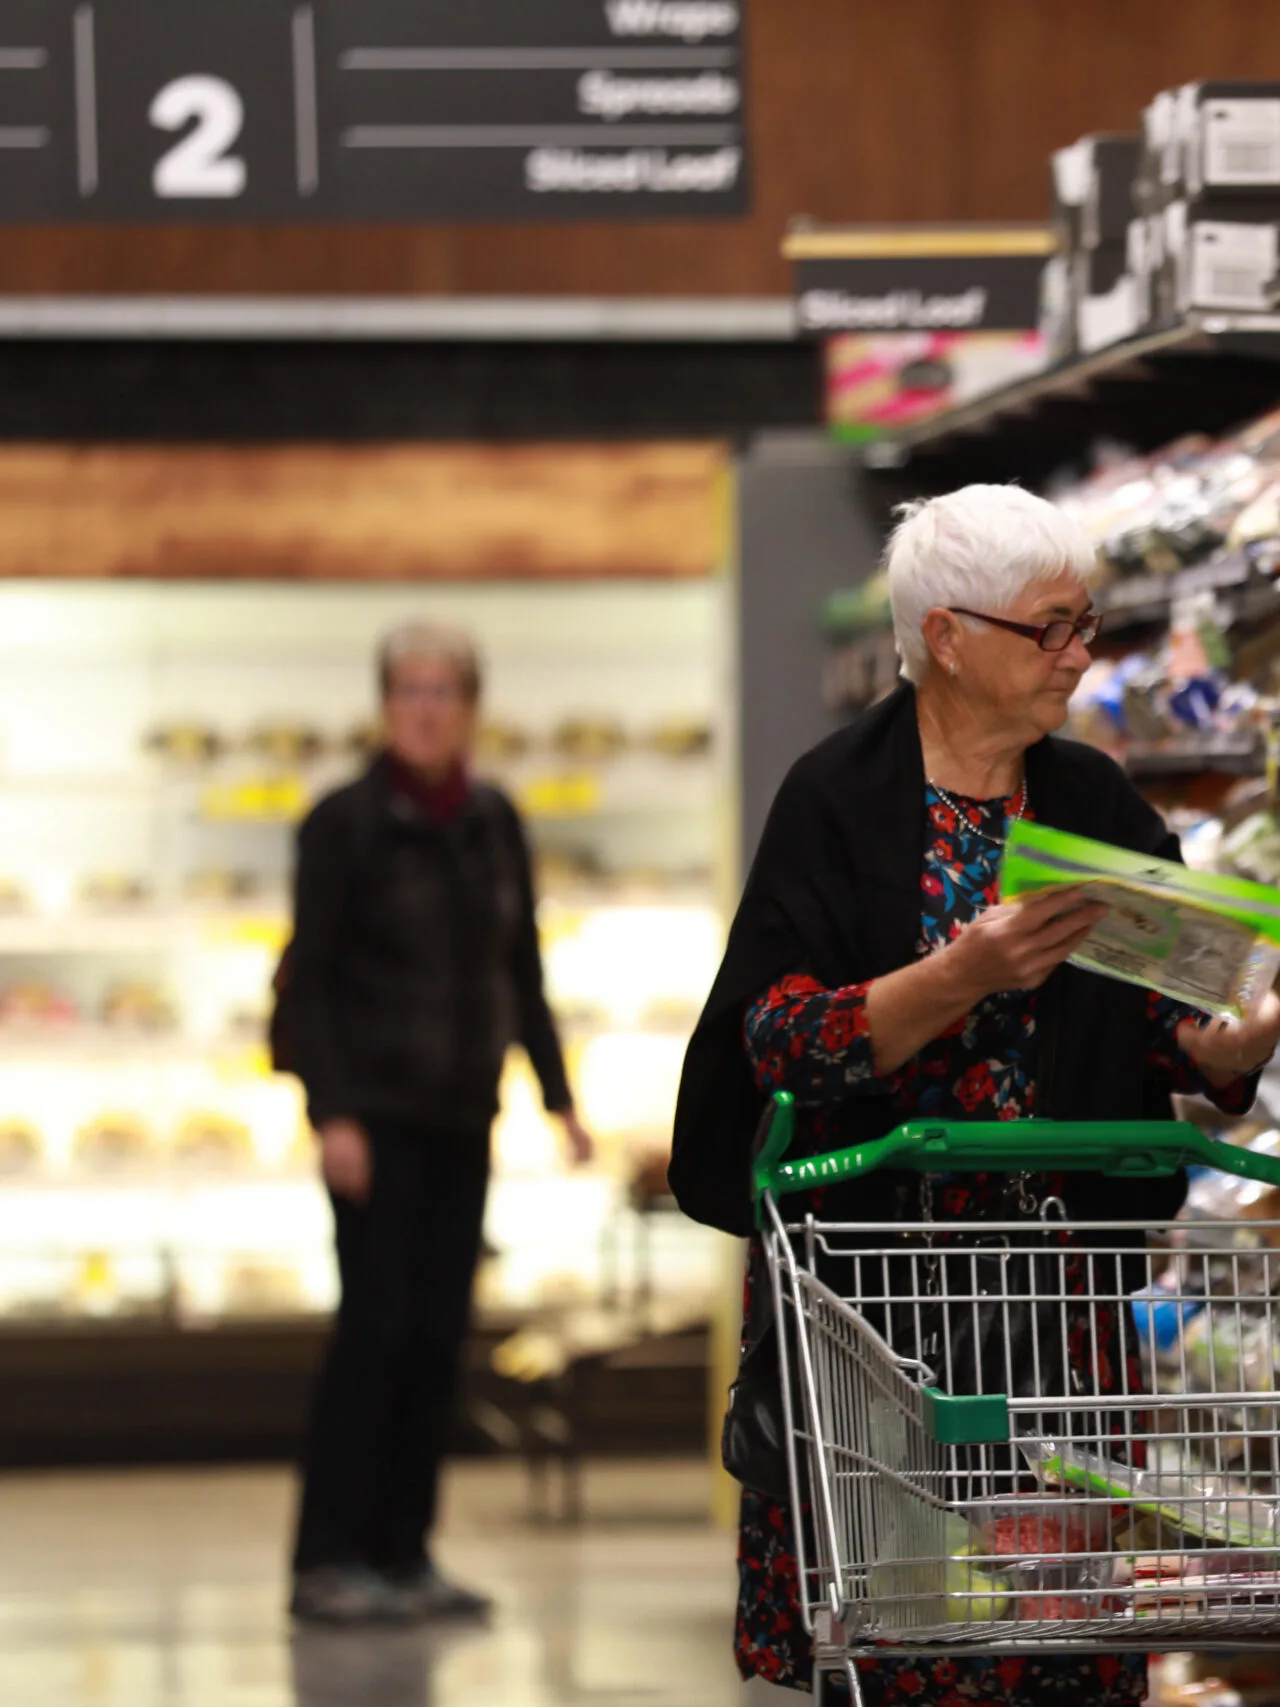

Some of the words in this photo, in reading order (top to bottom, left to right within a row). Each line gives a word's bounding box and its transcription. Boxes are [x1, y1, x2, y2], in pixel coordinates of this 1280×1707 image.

[577, 69, 740, 120] Spreads
[149, 73, 247, 199] 2
[525, 146, 641, 192] Sliced
[644, 147, 741, 192] Loaf
[802, 289, 905, 329] Sliced
[907, 286, 987, 328] Loaf
